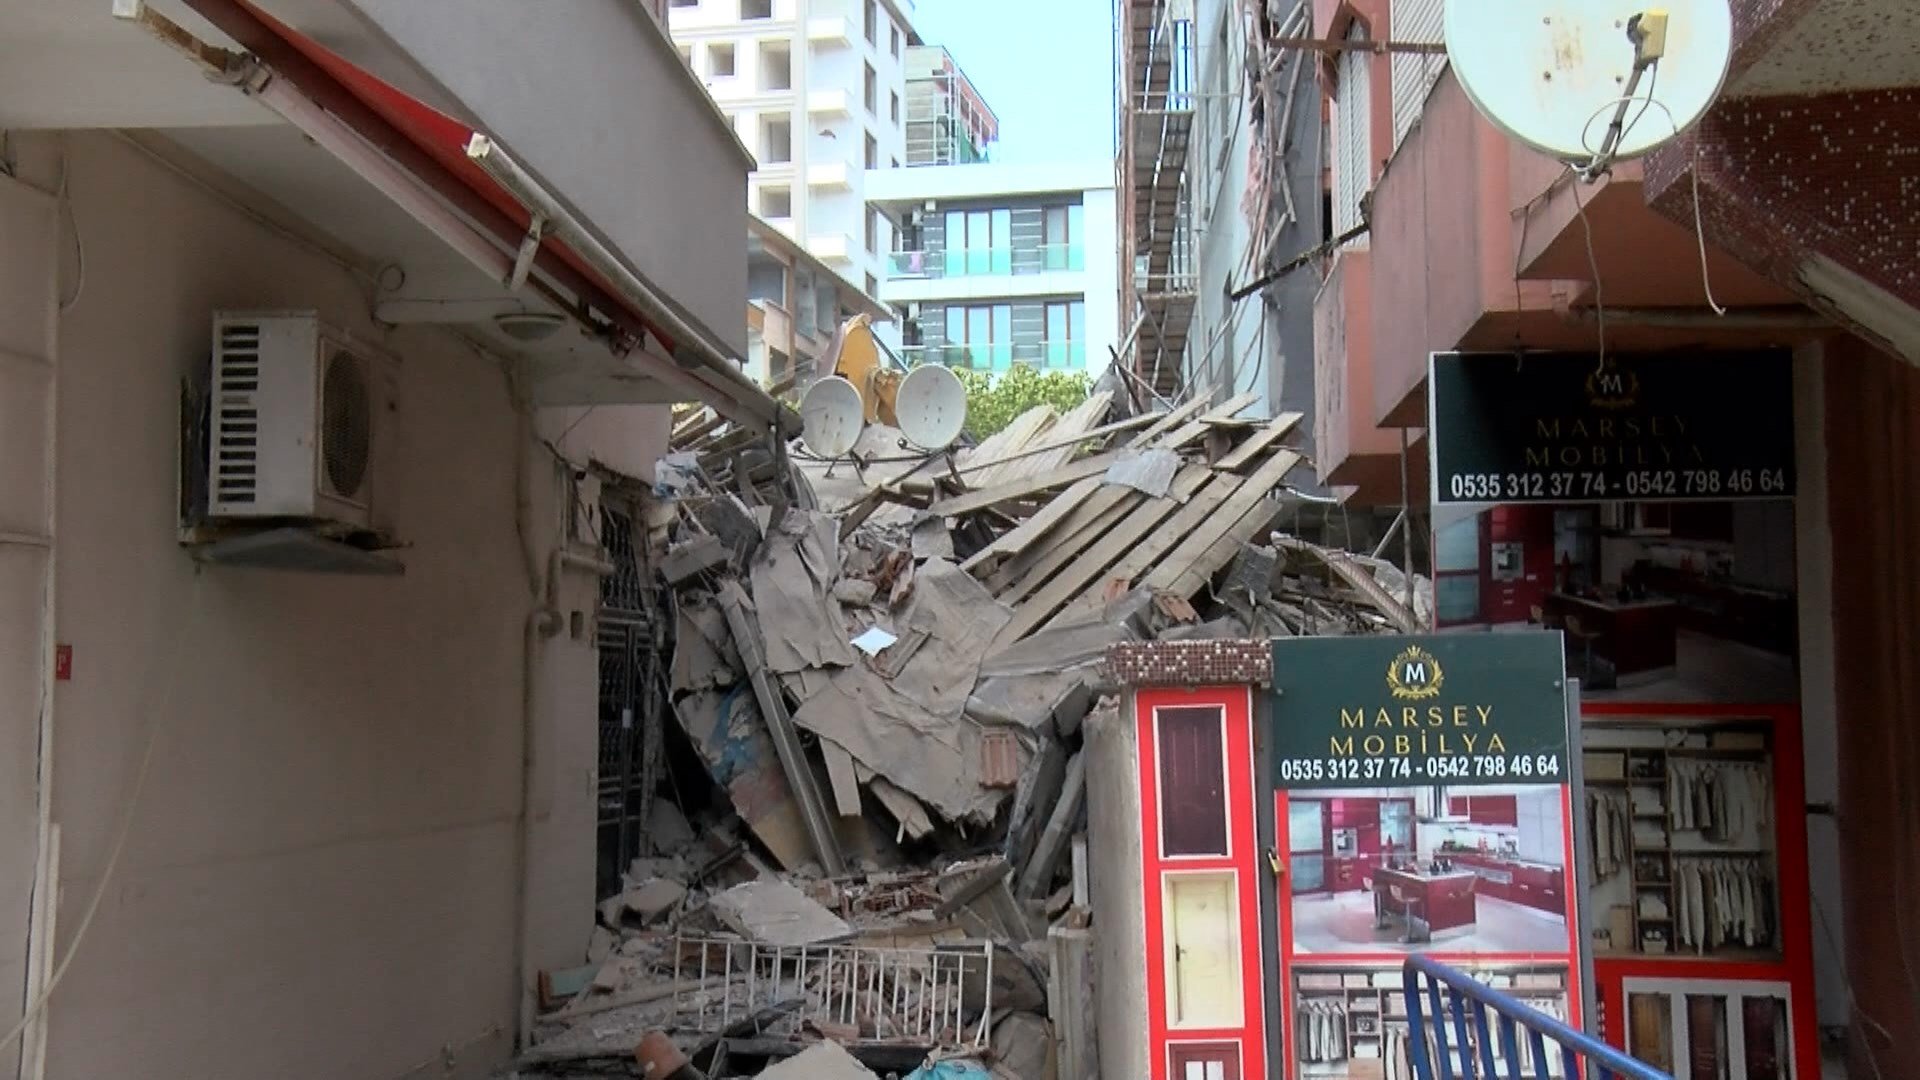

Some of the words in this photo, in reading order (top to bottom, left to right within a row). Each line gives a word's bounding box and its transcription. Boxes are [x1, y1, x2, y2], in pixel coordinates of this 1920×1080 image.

[1537, 415, 1691, 438] MARSEY
[1451, 473, 1501, 498] 0535
[1507, 473, 1544, 497] 312
[1551, 473, 1577, 496] 37
[1581, 472, 1606, 496] 74
[1626, 471, 1676, 495] 0542
[1683, 470, 1721, 494] 798
[1727, 469, 1753, 492] 46
[1760, 468, 1786, 492] 64
[1405, 663, 1426, 684] M
[1340, 705, 1494, 728] MARSEY
[1330, 729, 1507, 756] MOBİLYA
[1281, 759, 1323, 780] 0535
[1328, 758, 1359, 779] 312
[1364, 758, 1385, 778] 37
[1389, 757, 1411, 778] 74
[1426, 756, 1469, 777] 0542
[1474, 755, 1506, 776] 798
[1511, 755, 1533, 775] 46
[1537, 754, 1559, 775] 64
